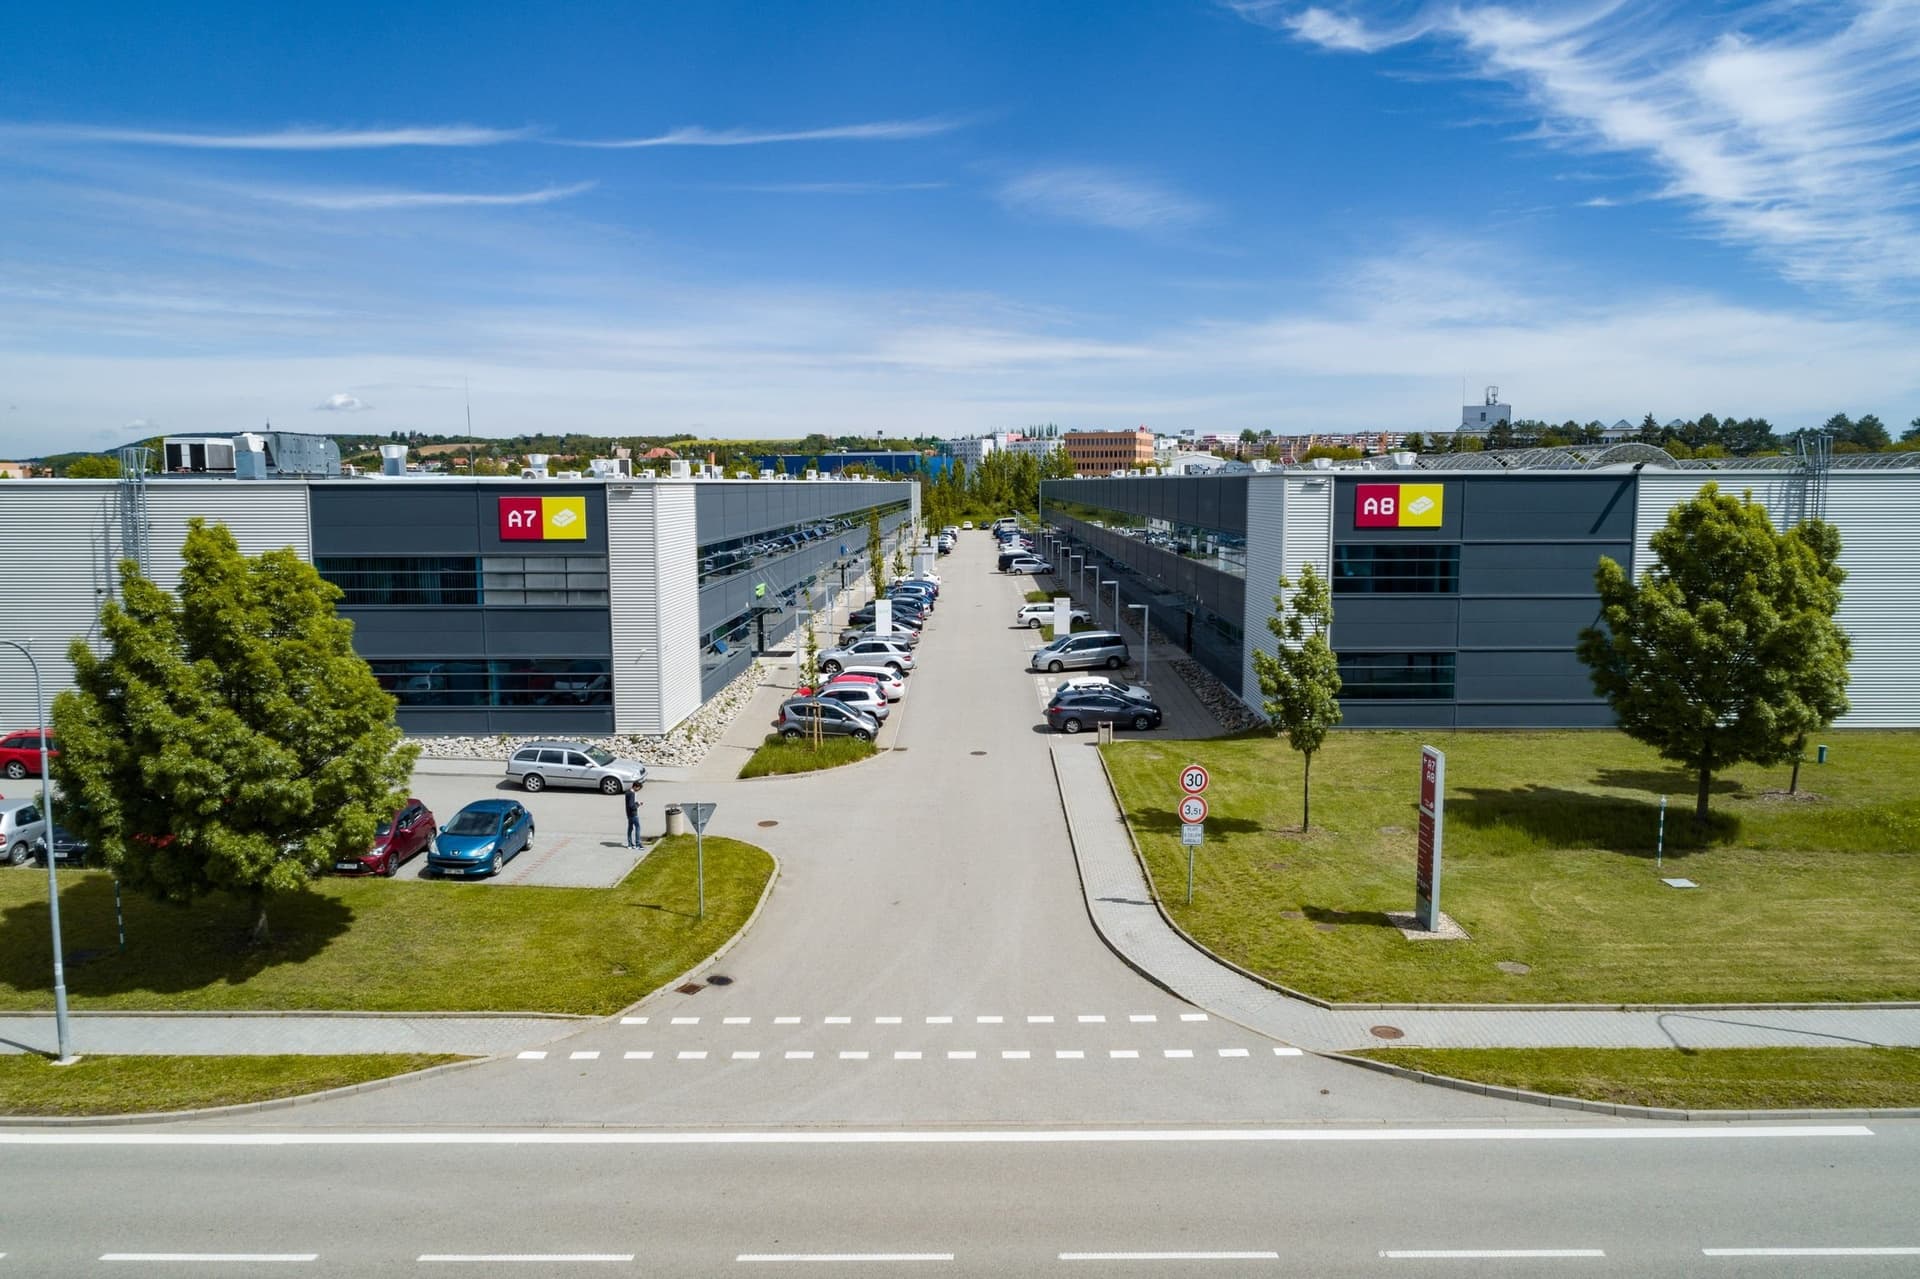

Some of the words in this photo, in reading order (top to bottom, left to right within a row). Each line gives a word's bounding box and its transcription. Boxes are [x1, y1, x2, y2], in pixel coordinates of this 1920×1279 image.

[1363, 497, 1395, 515] A8
[508, 510, 537, 528] A7
[1427, 759, 1436, 771] A7
[1186, 773, 1203, 787] 30
[1426, 770, 1435, 783] A8
